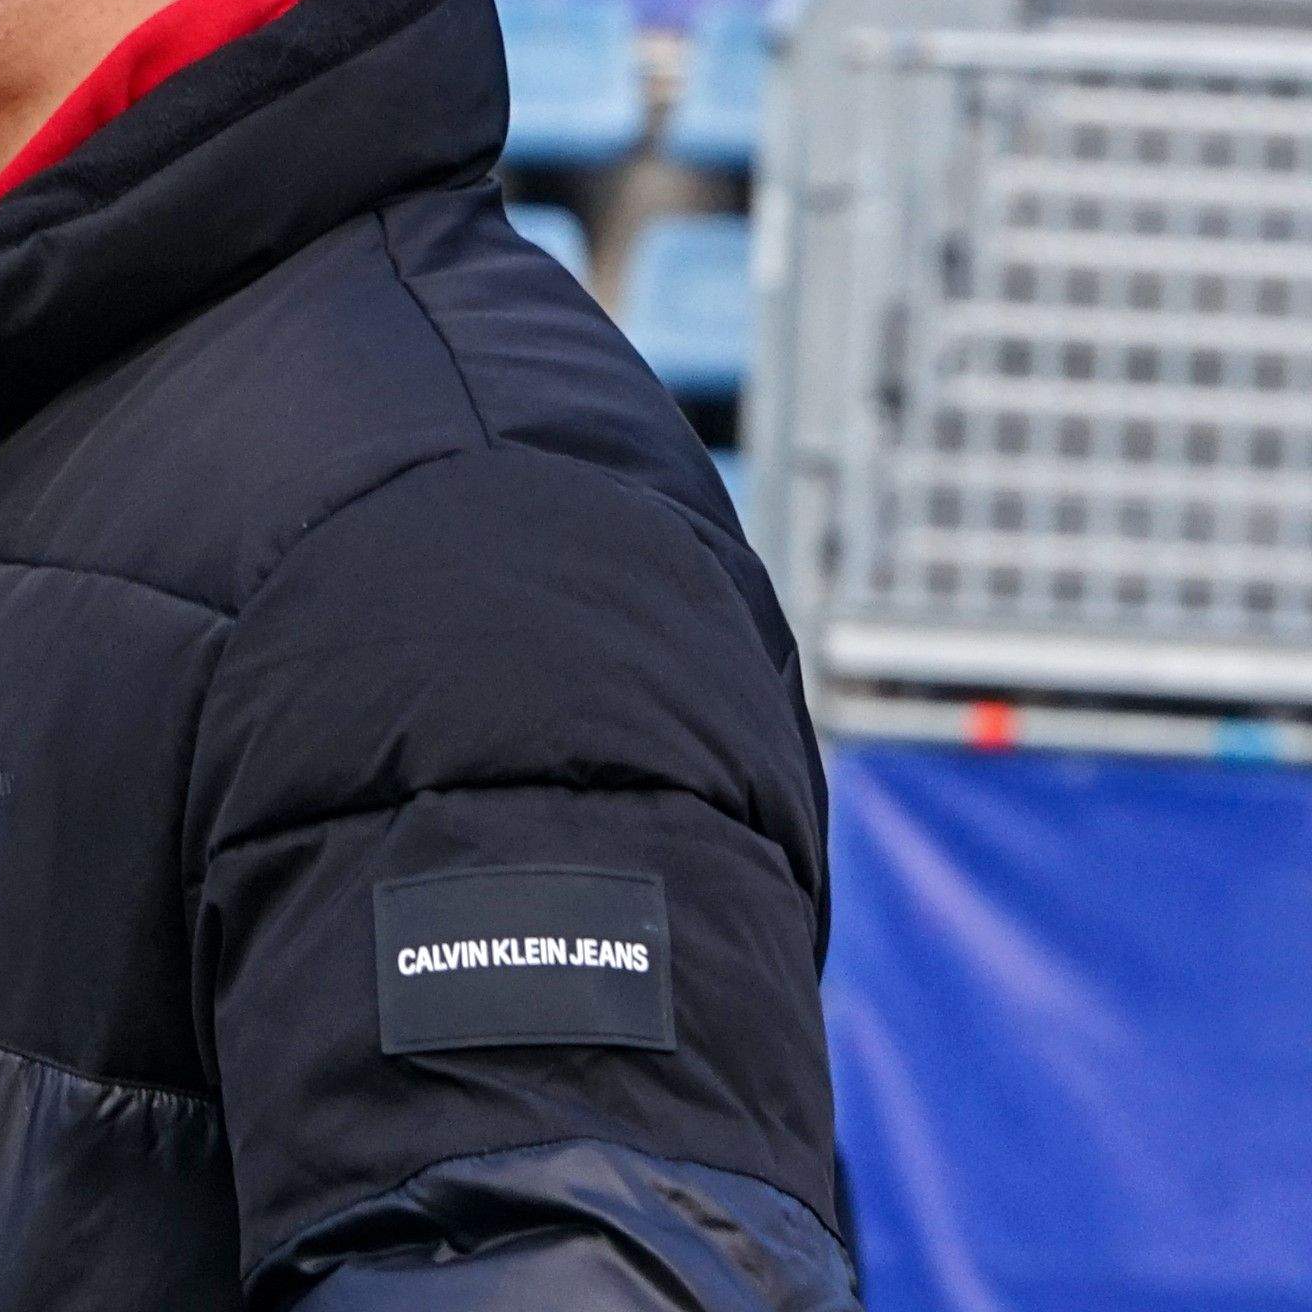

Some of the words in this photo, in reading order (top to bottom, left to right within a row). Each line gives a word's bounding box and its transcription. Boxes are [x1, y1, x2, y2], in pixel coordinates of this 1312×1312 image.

[397, 939, 489, 976] CALVIN
[491, 936, 568, 967] KLEIN
[569, 938, 650, 973] JEANS
